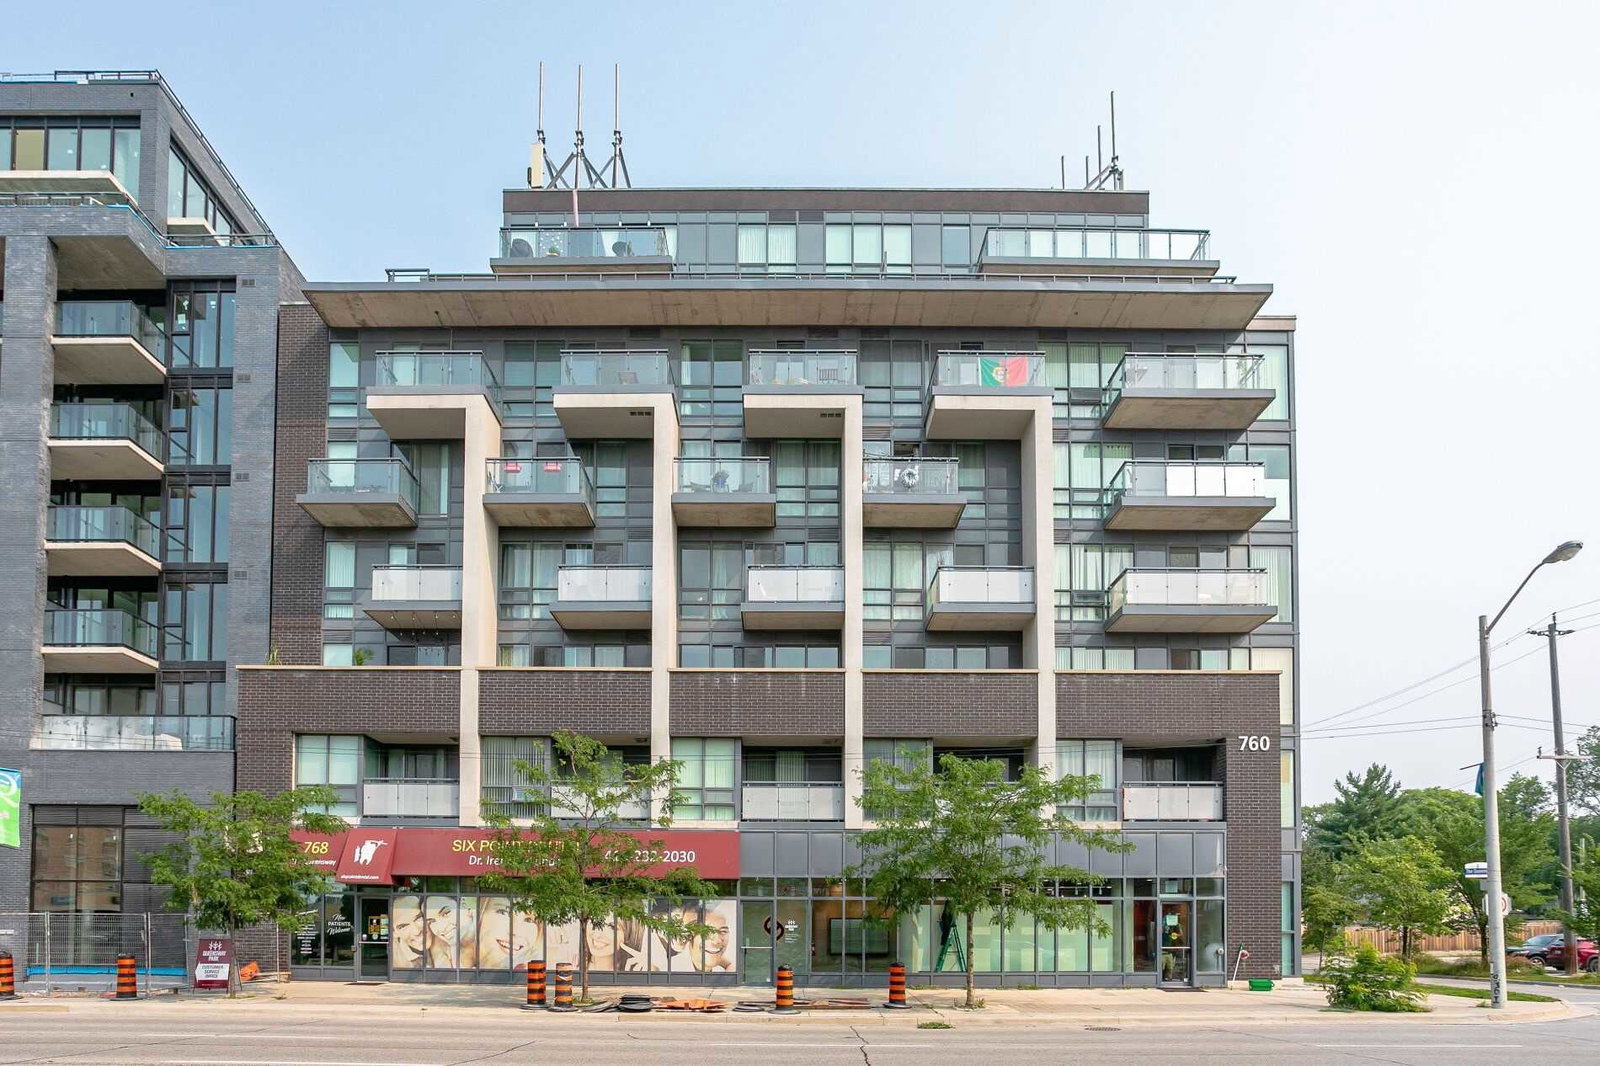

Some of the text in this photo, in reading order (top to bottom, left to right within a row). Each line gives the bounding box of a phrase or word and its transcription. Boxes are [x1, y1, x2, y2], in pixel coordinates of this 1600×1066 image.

[1238, 735, 1270, 751] 760
[304, 841, 329, 854] 768
[452, 839, 476, 852] SIX
[468, 855, 483, 866] Dr.
[604, 850, 696, 863] 4-232-2030
